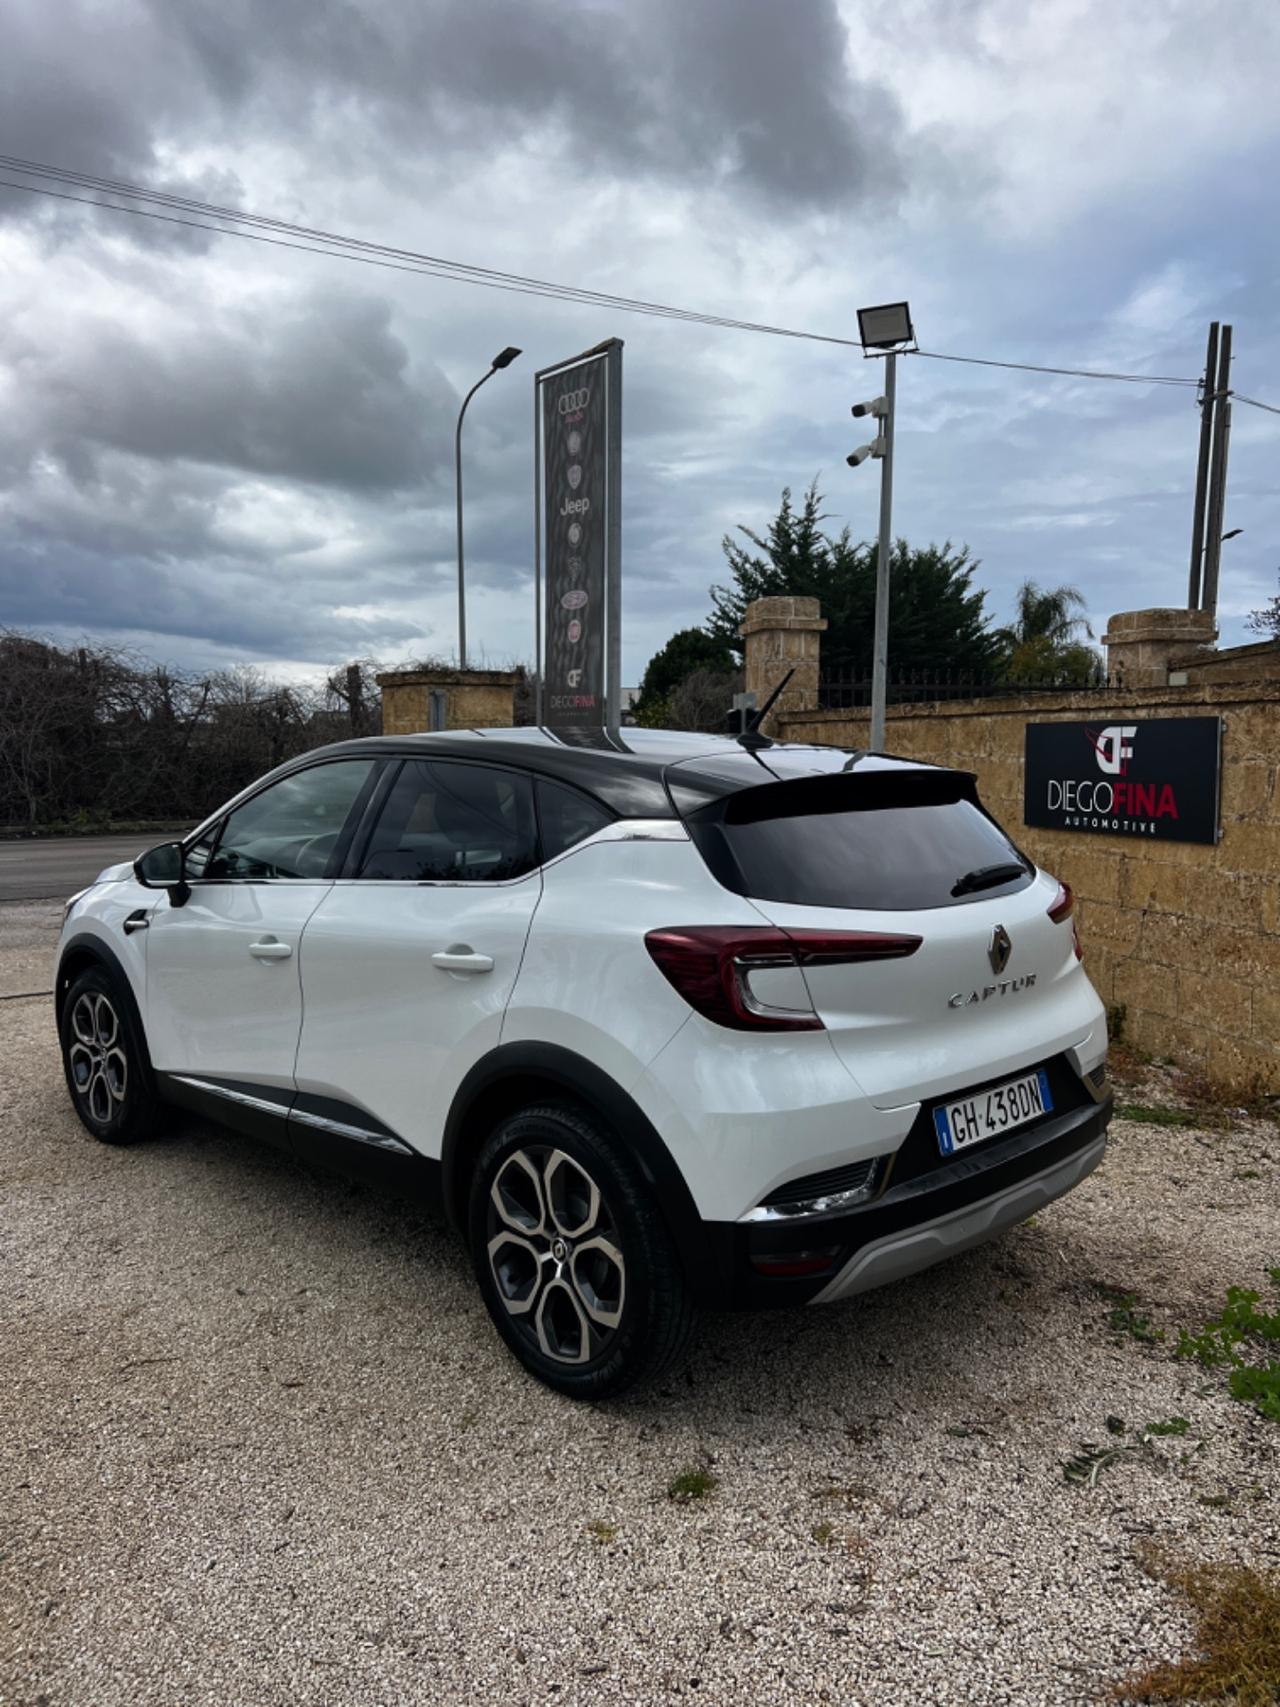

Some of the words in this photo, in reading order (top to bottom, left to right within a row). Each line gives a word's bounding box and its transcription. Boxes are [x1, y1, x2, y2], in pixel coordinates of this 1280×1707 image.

[560, 497, 590, 516] Jeep
[1064, 816, 1156, 834] AUTOMOTIVE
[948, 973, 1037, 1009] CAPTUR
